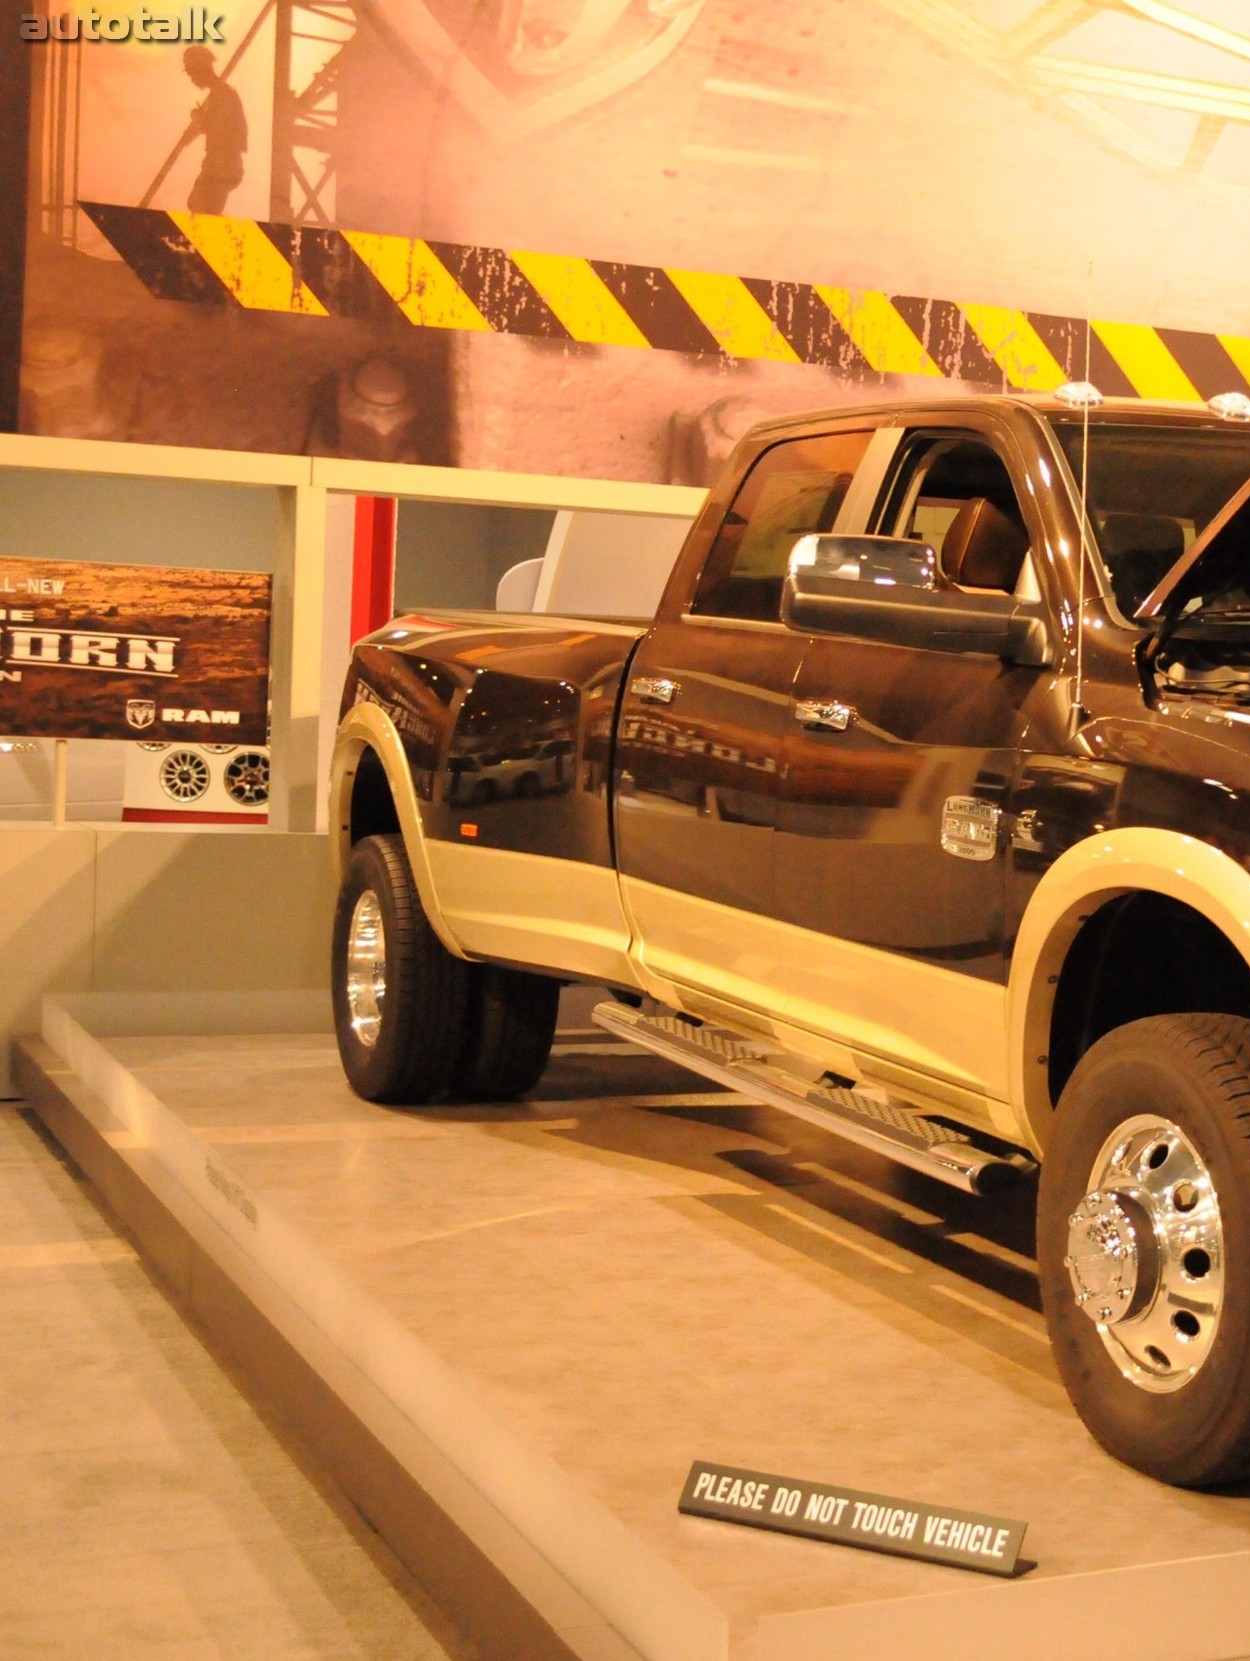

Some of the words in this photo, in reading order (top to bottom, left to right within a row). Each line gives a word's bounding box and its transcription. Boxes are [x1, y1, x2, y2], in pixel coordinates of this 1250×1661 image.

[0, 630, 177, 673] ORN
[162, 708, 240, 724] RAM
[693, 1472, 769, 1511] PLEASE
[771, 1487, 802, 1517] DO
[804, 1494, 850, 1525] NOT
[851, 1501, 919, 1540] TOUCH
[923, 1516, 1010, 1558] VEHICLE
